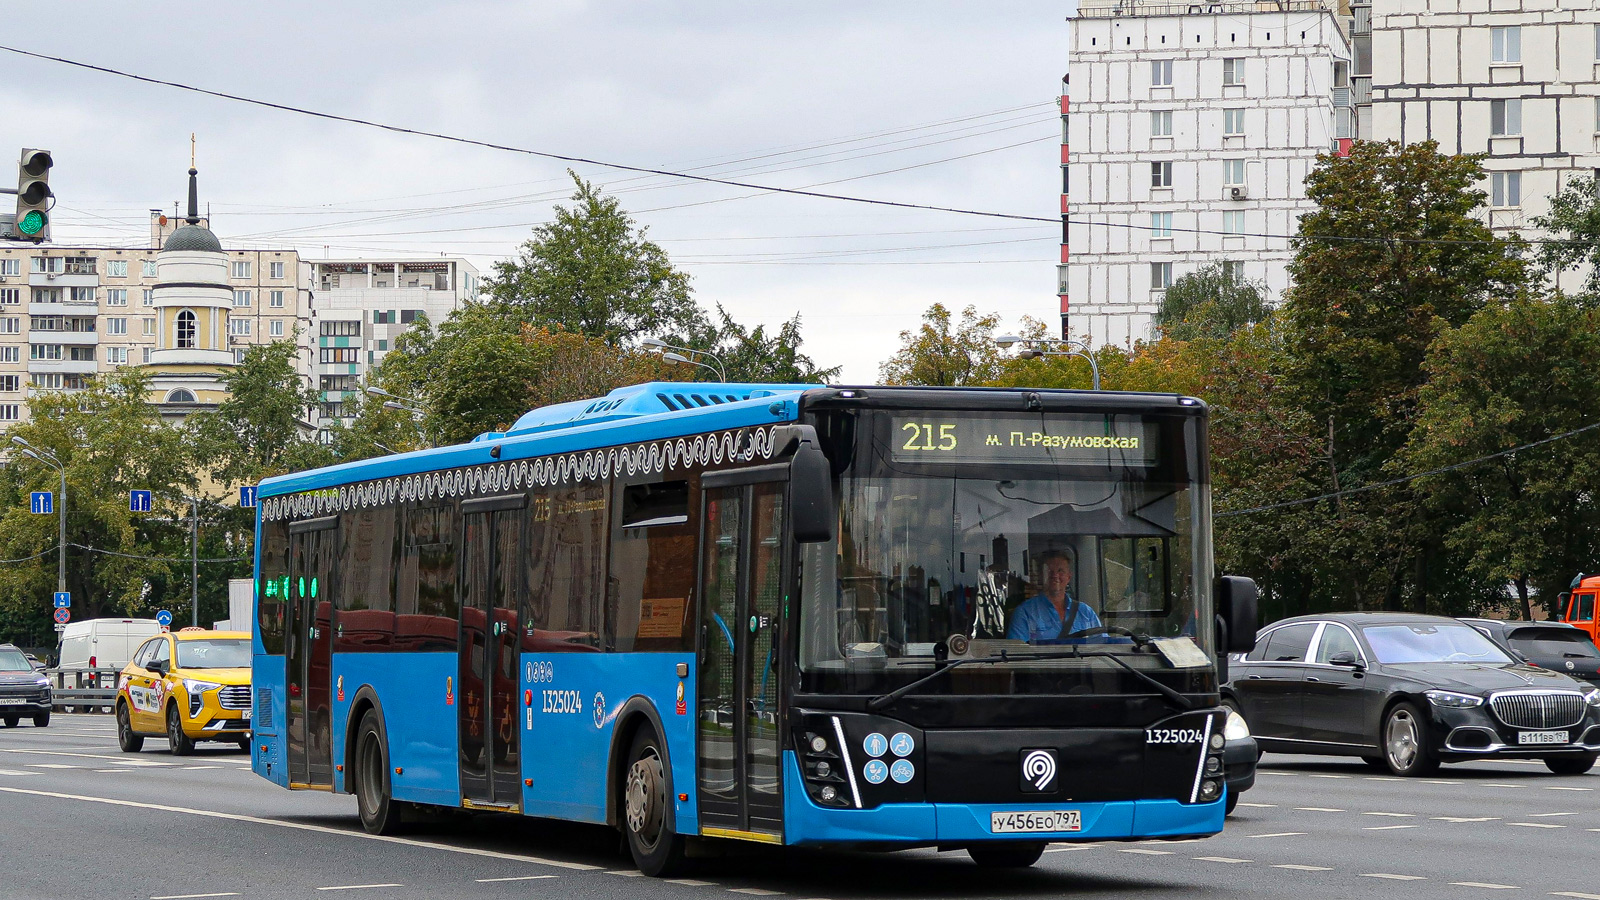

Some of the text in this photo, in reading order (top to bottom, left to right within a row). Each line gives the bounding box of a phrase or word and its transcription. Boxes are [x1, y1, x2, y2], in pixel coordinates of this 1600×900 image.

[901, 422, 1139, 451] 215 м. П.-Разумовская
[542, 690, 583, 714] 1325024
[1146, 729, 1203, 744] 1325024
